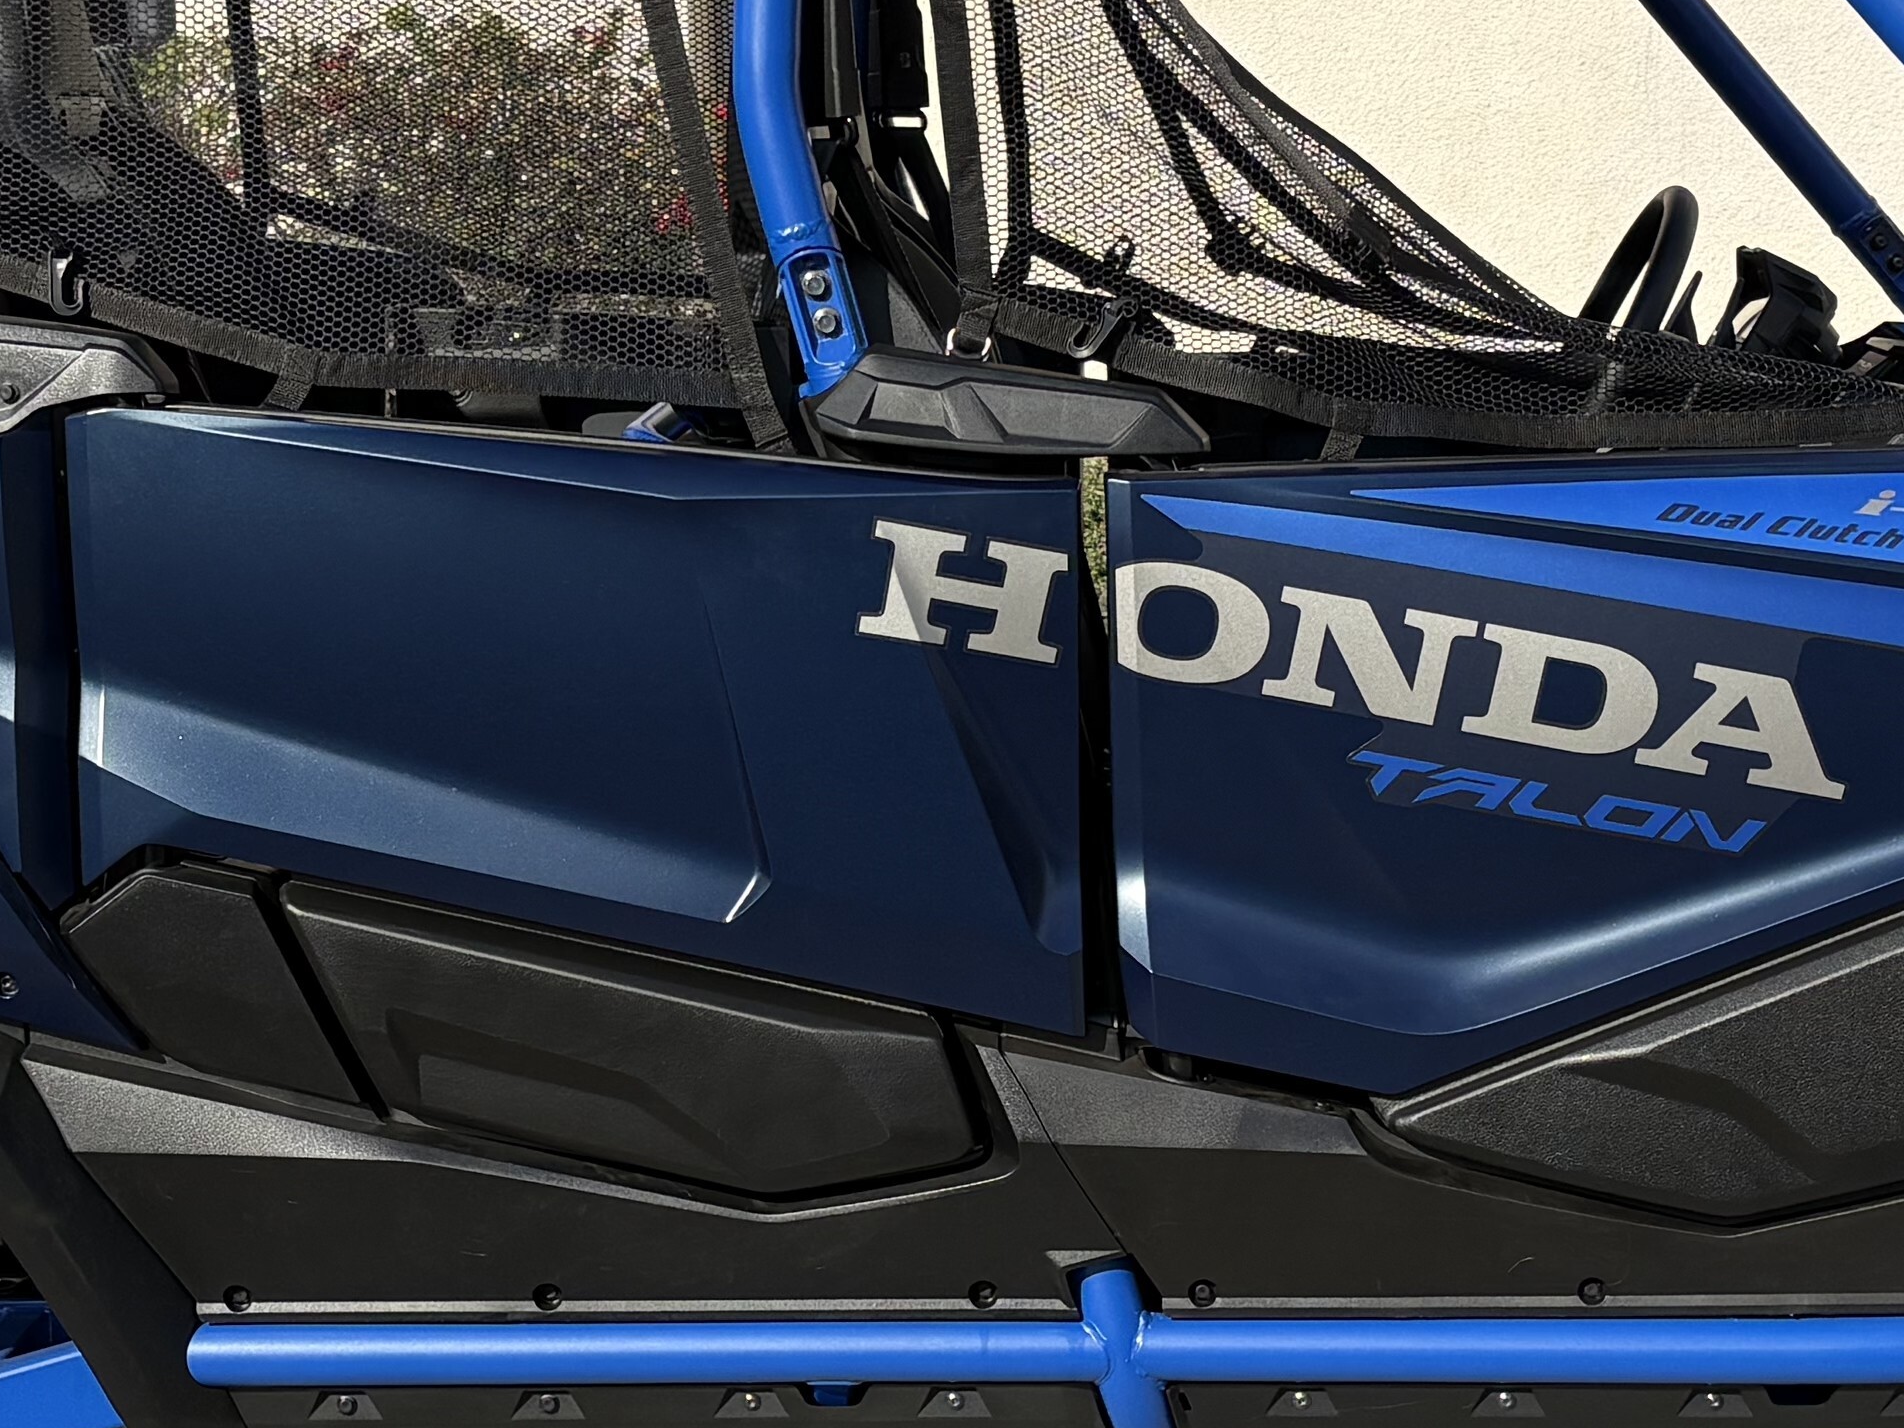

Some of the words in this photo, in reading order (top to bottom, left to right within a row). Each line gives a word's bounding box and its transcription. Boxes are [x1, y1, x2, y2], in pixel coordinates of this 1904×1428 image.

[1655, 502, 1760, 532] Dual
[1765, 515, 1904, 550] Clutch
[854, 516, 1846, 801] HONDA
[1349, 750, 1768, 854] TALON
